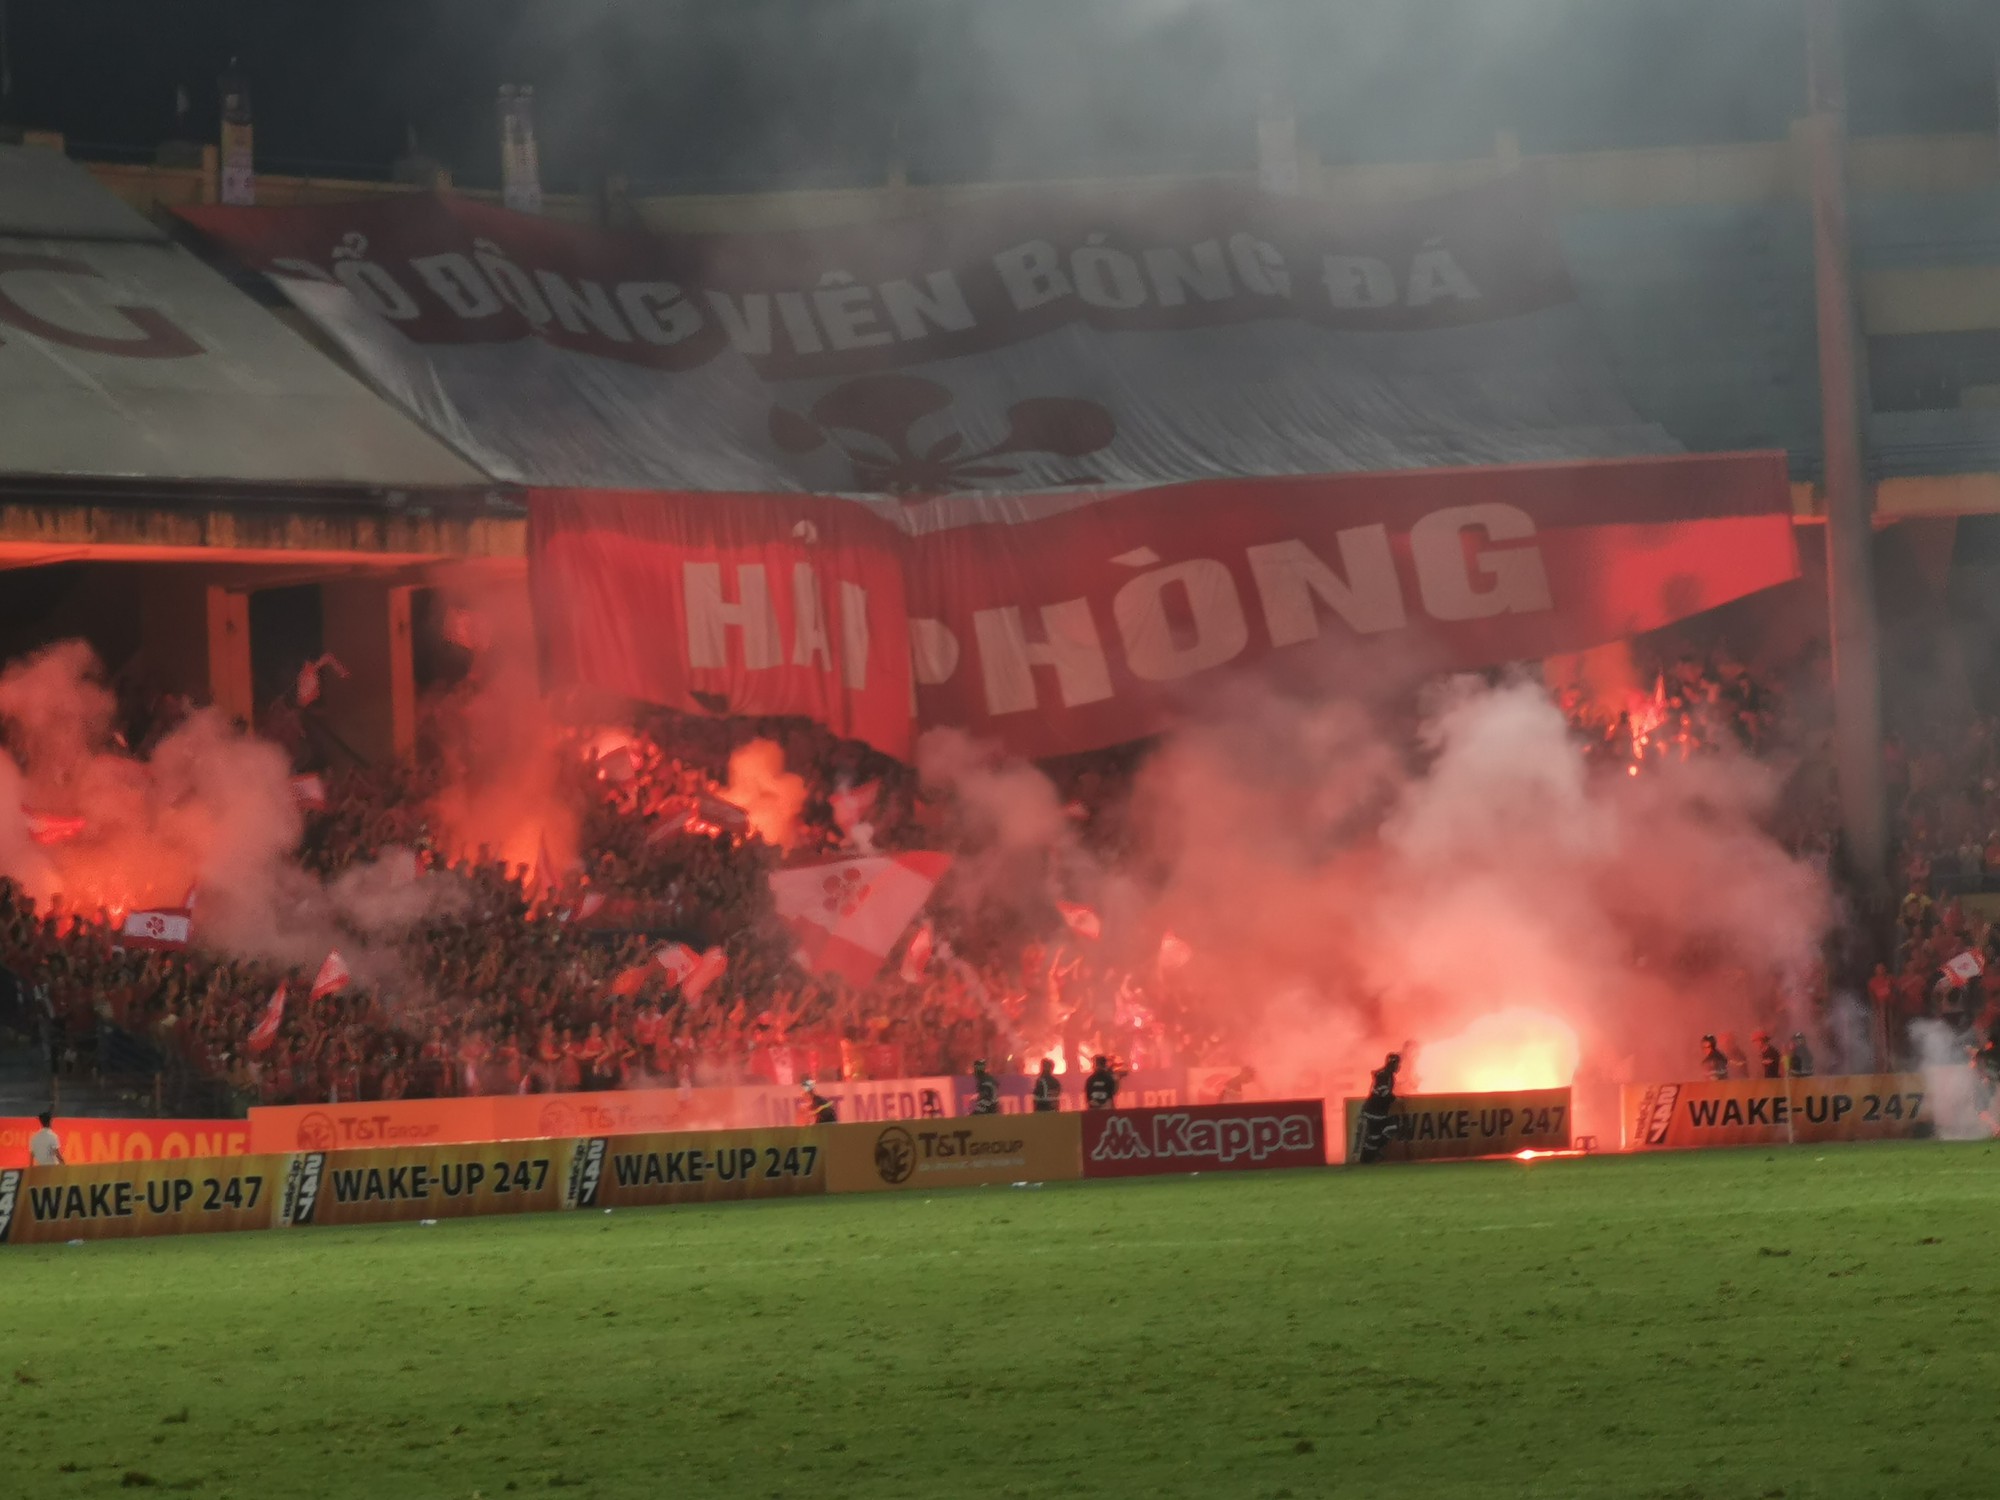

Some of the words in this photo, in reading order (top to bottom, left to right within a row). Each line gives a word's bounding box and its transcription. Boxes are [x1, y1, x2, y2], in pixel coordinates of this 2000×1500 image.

[704, 270, 977, 355] VIÊN
[994, 232, 1292, 311] BÓNG
[1320, 237, 1483, 309] ĐÁ
[683, 519, 869, 691] HẢI
[908, 502, 1555, 718] PHÒNG
[1520, 1106, 1566, 1135] 247
[1688, 1093, 1852, 1127] WAKE-UP
[1862, 1091, 1925, 1122] 247
[64, 1131, 152, 1166] ANO
[918, 1129, 972, 1157] T&T
[1153, 1113, 1315, 1162] Kappa
[297, 1154, 323, 1221] 247
[332, 1162, 485, 1201] WAKE-UP
[493, 1159, 550, 1193] 247
[581, 1139, 605, 1204] 247
[614, 1147, 757, 1187] WAKE-UP
[765, 1146, 818, 1178] 247
[30, 1178, 194, 1221] WAKE-UP
[203, 1175, 263, 1210] 247
